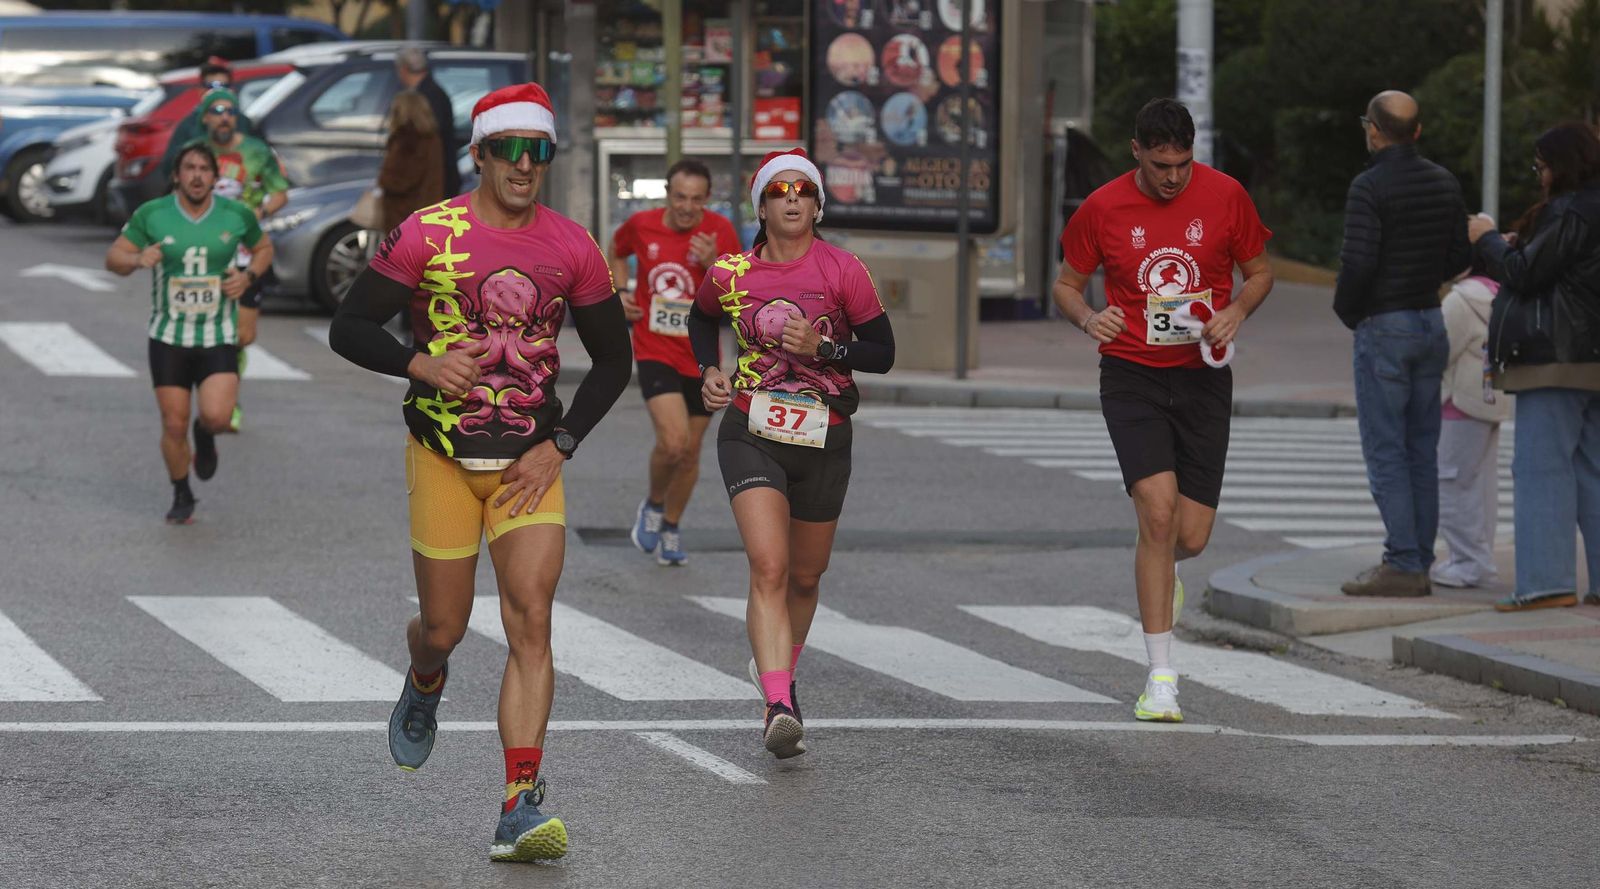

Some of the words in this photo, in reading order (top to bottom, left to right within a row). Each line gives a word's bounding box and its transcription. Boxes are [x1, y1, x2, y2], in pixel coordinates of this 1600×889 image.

[1137, 257, 1152, 284] CARRERA
[1149, 247, 1184, 260] SOLIDARIA
[1183, 252, 1194, 262] DE
[1190, 258, 1201, 287] NAVIDAD
[174, 290, 213, 304] 418
[1153, 313, 1189, 331] 3
[767, 405, 808, 430] 37
[736, 476, 771, 488] LURBEL
